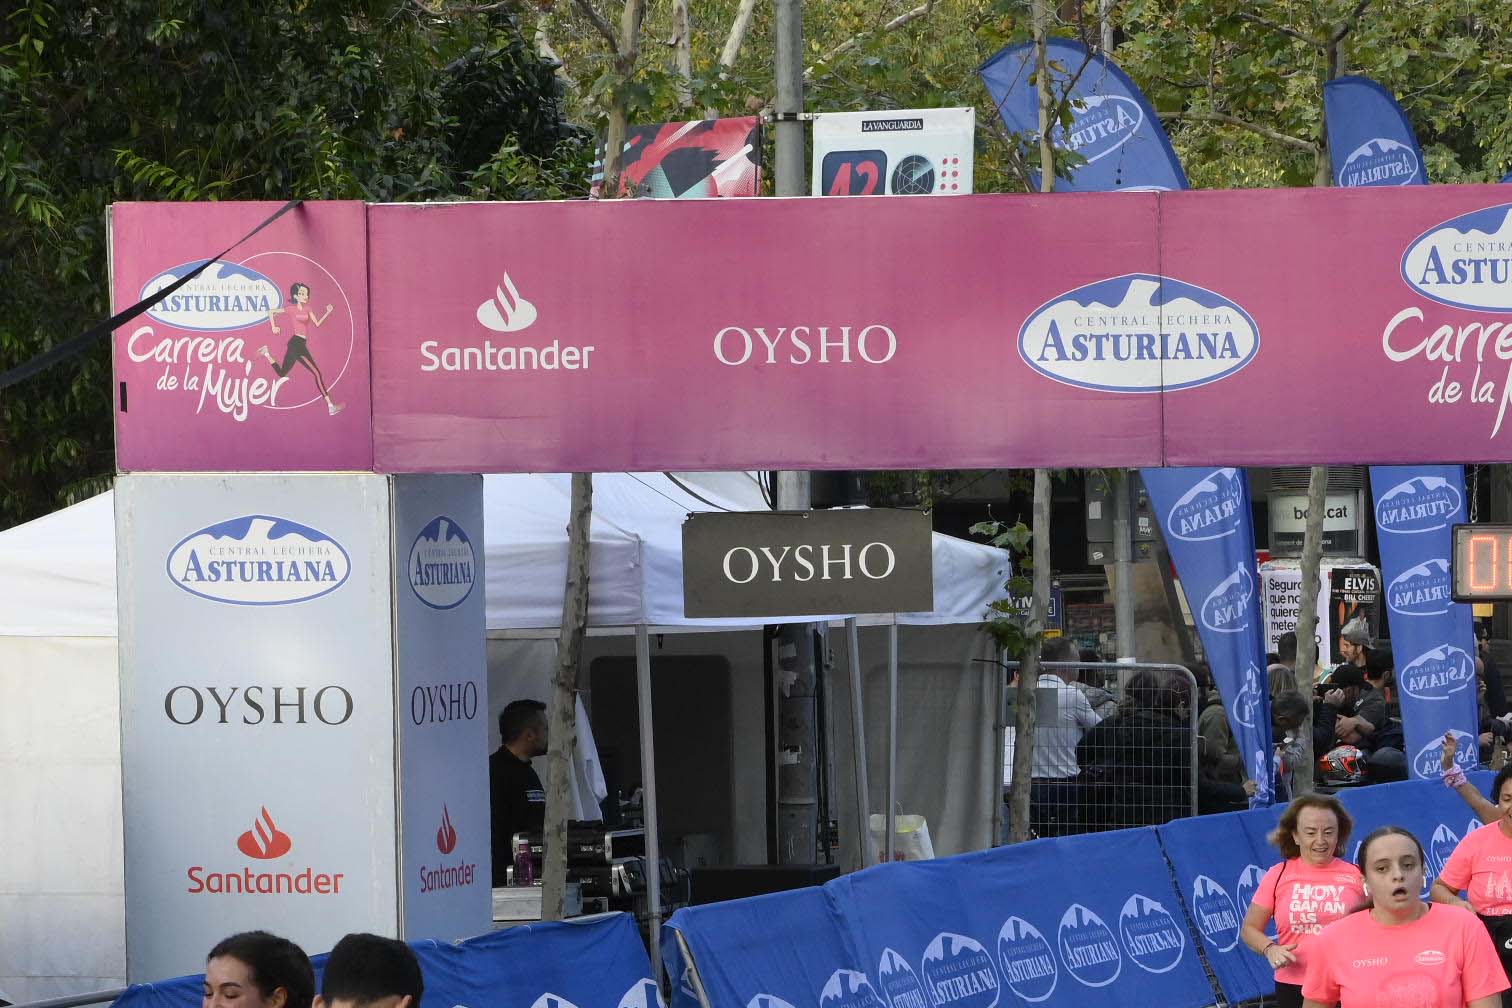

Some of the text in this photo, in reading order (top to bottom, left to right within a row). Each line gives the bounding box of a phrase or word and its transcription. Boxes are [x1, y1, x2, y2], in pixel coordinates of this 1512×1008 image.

[863, 119, 922, 131] LA VANGUARDIA
[1074, 314, 1232, 327] CENTRAL LECHERA
[128, 326, 245, 363] Carrera
[420, 340, 594, 371] Santander
[713, 324, 897, 365] OYSHO
[1037, 319, 1240, 361] ASTURIANA
[157, 361, 289, 421] de la Mujer
[1428, 365, 1462, 403] de
[1470, 364, 1495, 403] la
[181, 549, 337, 582] ASTURIANA
[209, 545, 331, 556] CENTRAL LECHERA
[722, 541, 896, 583] OYSHO
[414, 552, 472, 586] ASTURIANA
[1345, 578, 1375, 590] ELVIS
[1270, 596, 1285, 609] que
[165, 685, 354, 726] OYSHO
[411, 681, 478, 726] OYSHO
[187, 866, 344, 894] Santander
[420, 860, 476, 893] Santander
[1003, 951, 1054, 983] ASTURIANA
[1064, 938, 1118, 969] ASTURIANA
[1353, 957, 1389, 969] OYSHO
[927, 968, 997, 1005] ASTURIANA
